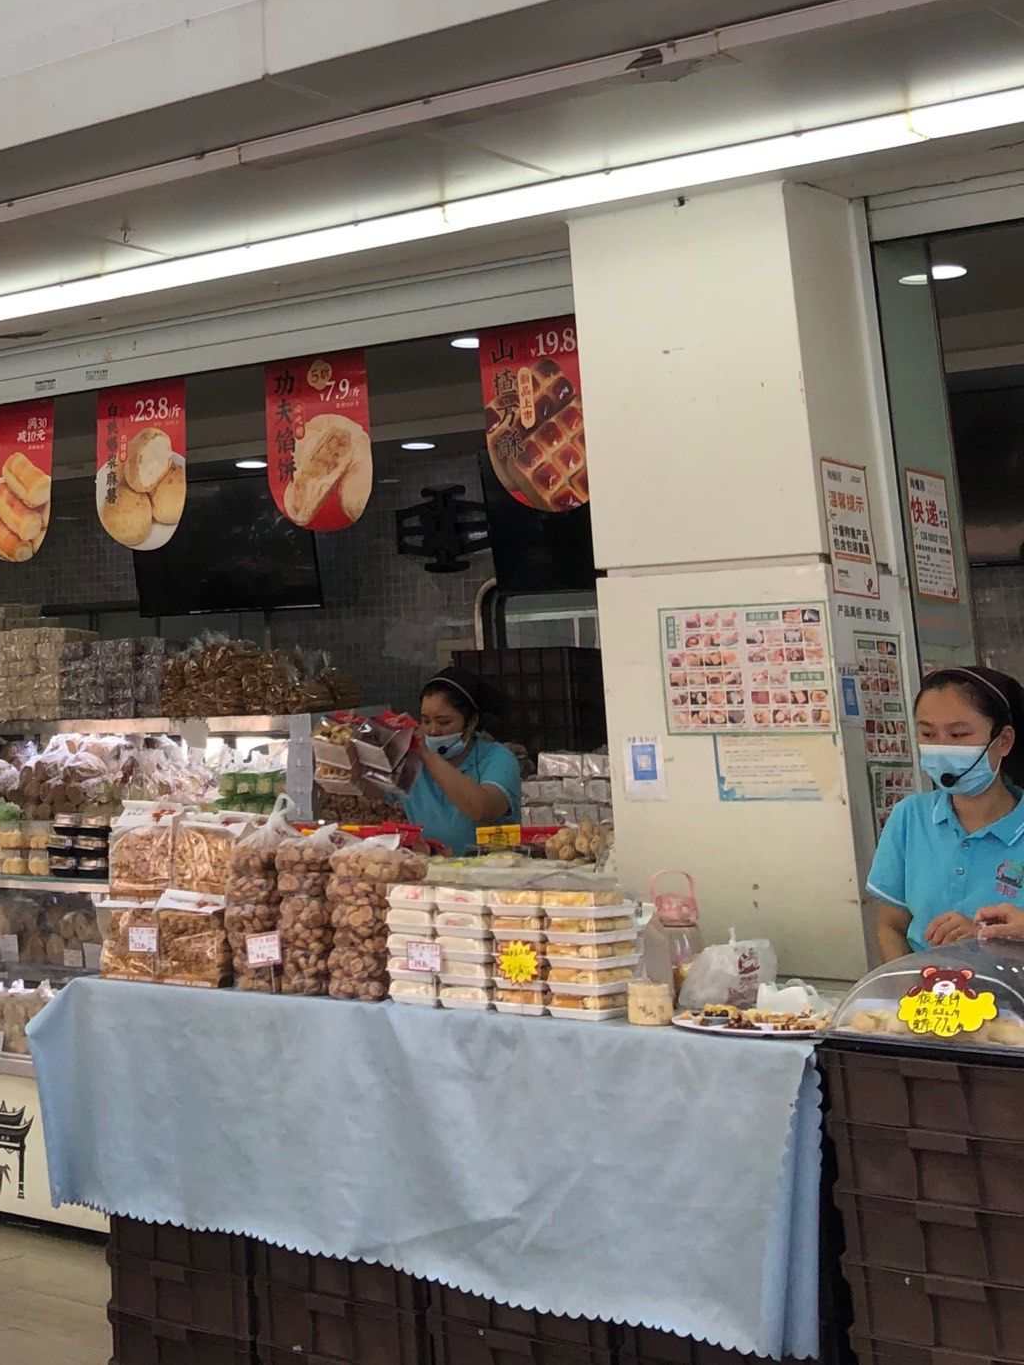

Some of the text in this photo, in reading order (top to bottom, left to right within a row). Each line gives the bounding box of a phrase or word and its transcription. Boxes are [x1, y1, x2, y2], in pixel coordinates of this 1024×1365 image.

[491, 338, 525, 458] 山楂方酥
[520, 374, 533, 421] 新品上市
[16, 429, 46, 443] 减10元
[27, 417, 48, 430] 满30
[273, 369, 298, 484] 功夫馅饼
[829, 491, 865, 513] 温馨提示
[910, 496, 940, 527] 快递
